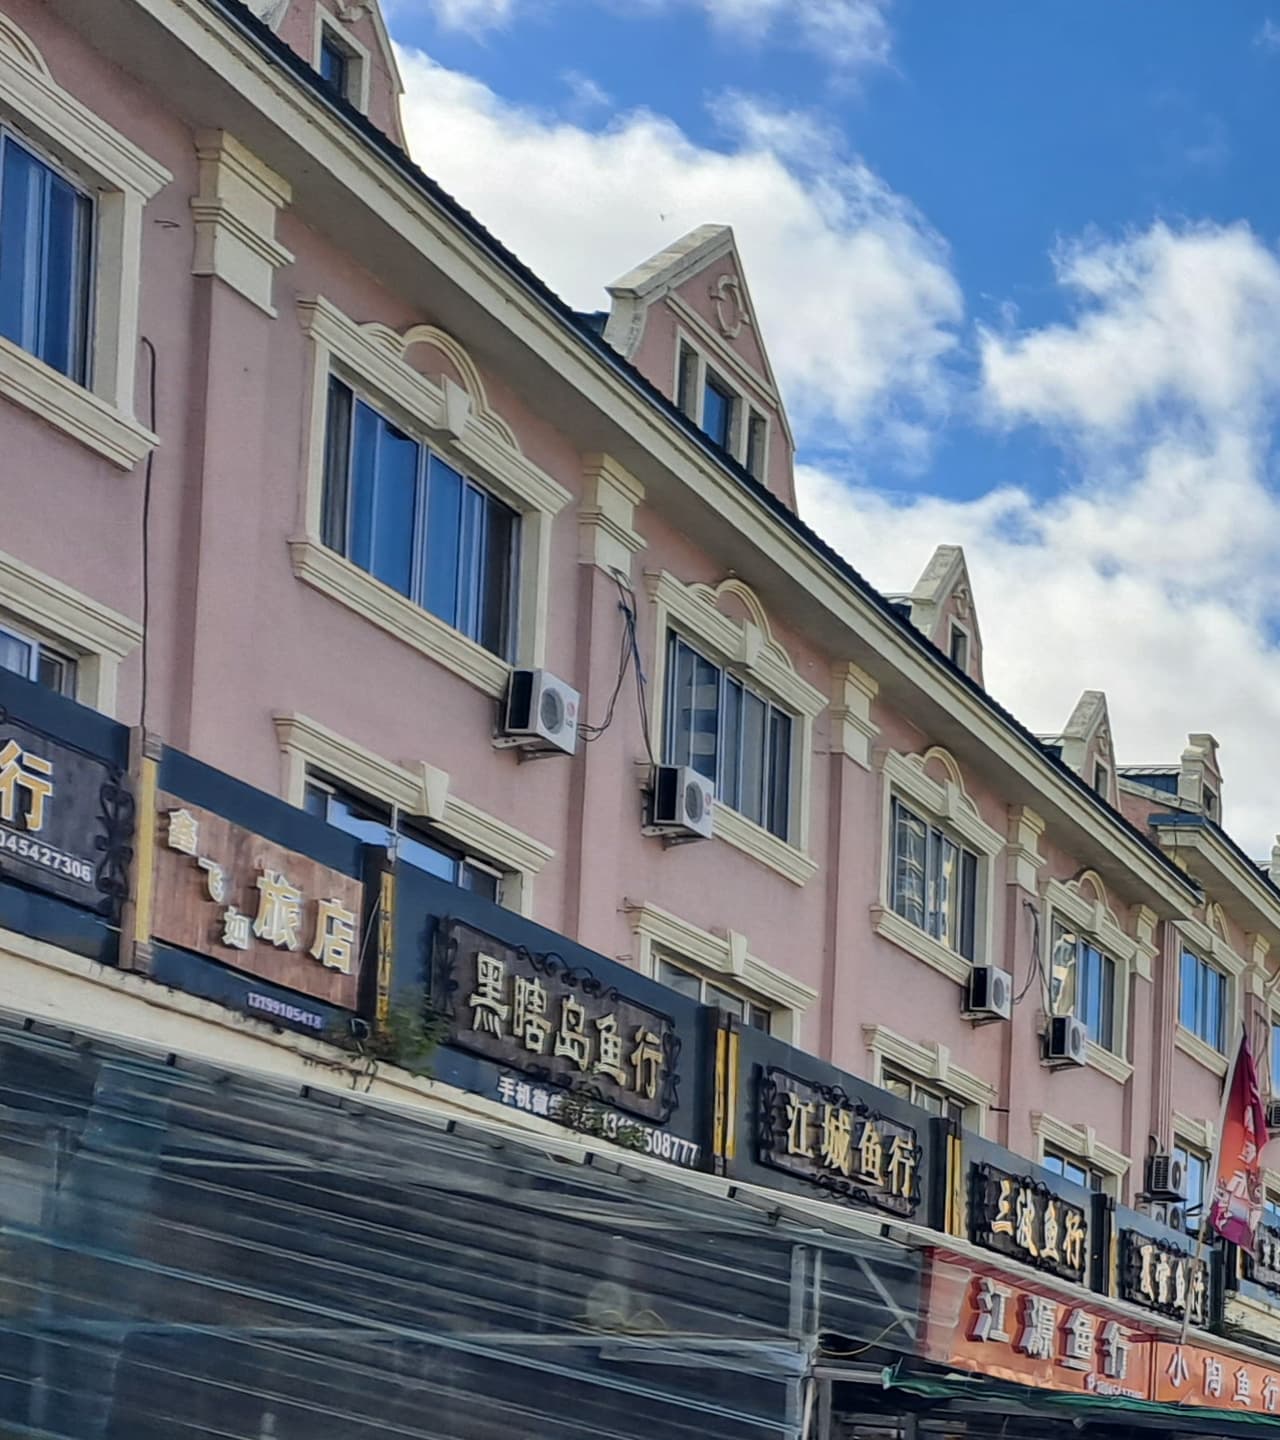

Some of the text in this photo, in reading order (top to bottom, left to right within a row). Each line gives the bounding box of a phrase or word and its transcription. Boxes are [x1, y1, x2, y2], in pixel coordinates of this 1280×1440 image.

[0, 739, 53, 831] 行
[469, 951, 664, 1099] 黑瞎岛鱼行
[601, 1110, 700, 1166] 13508777
